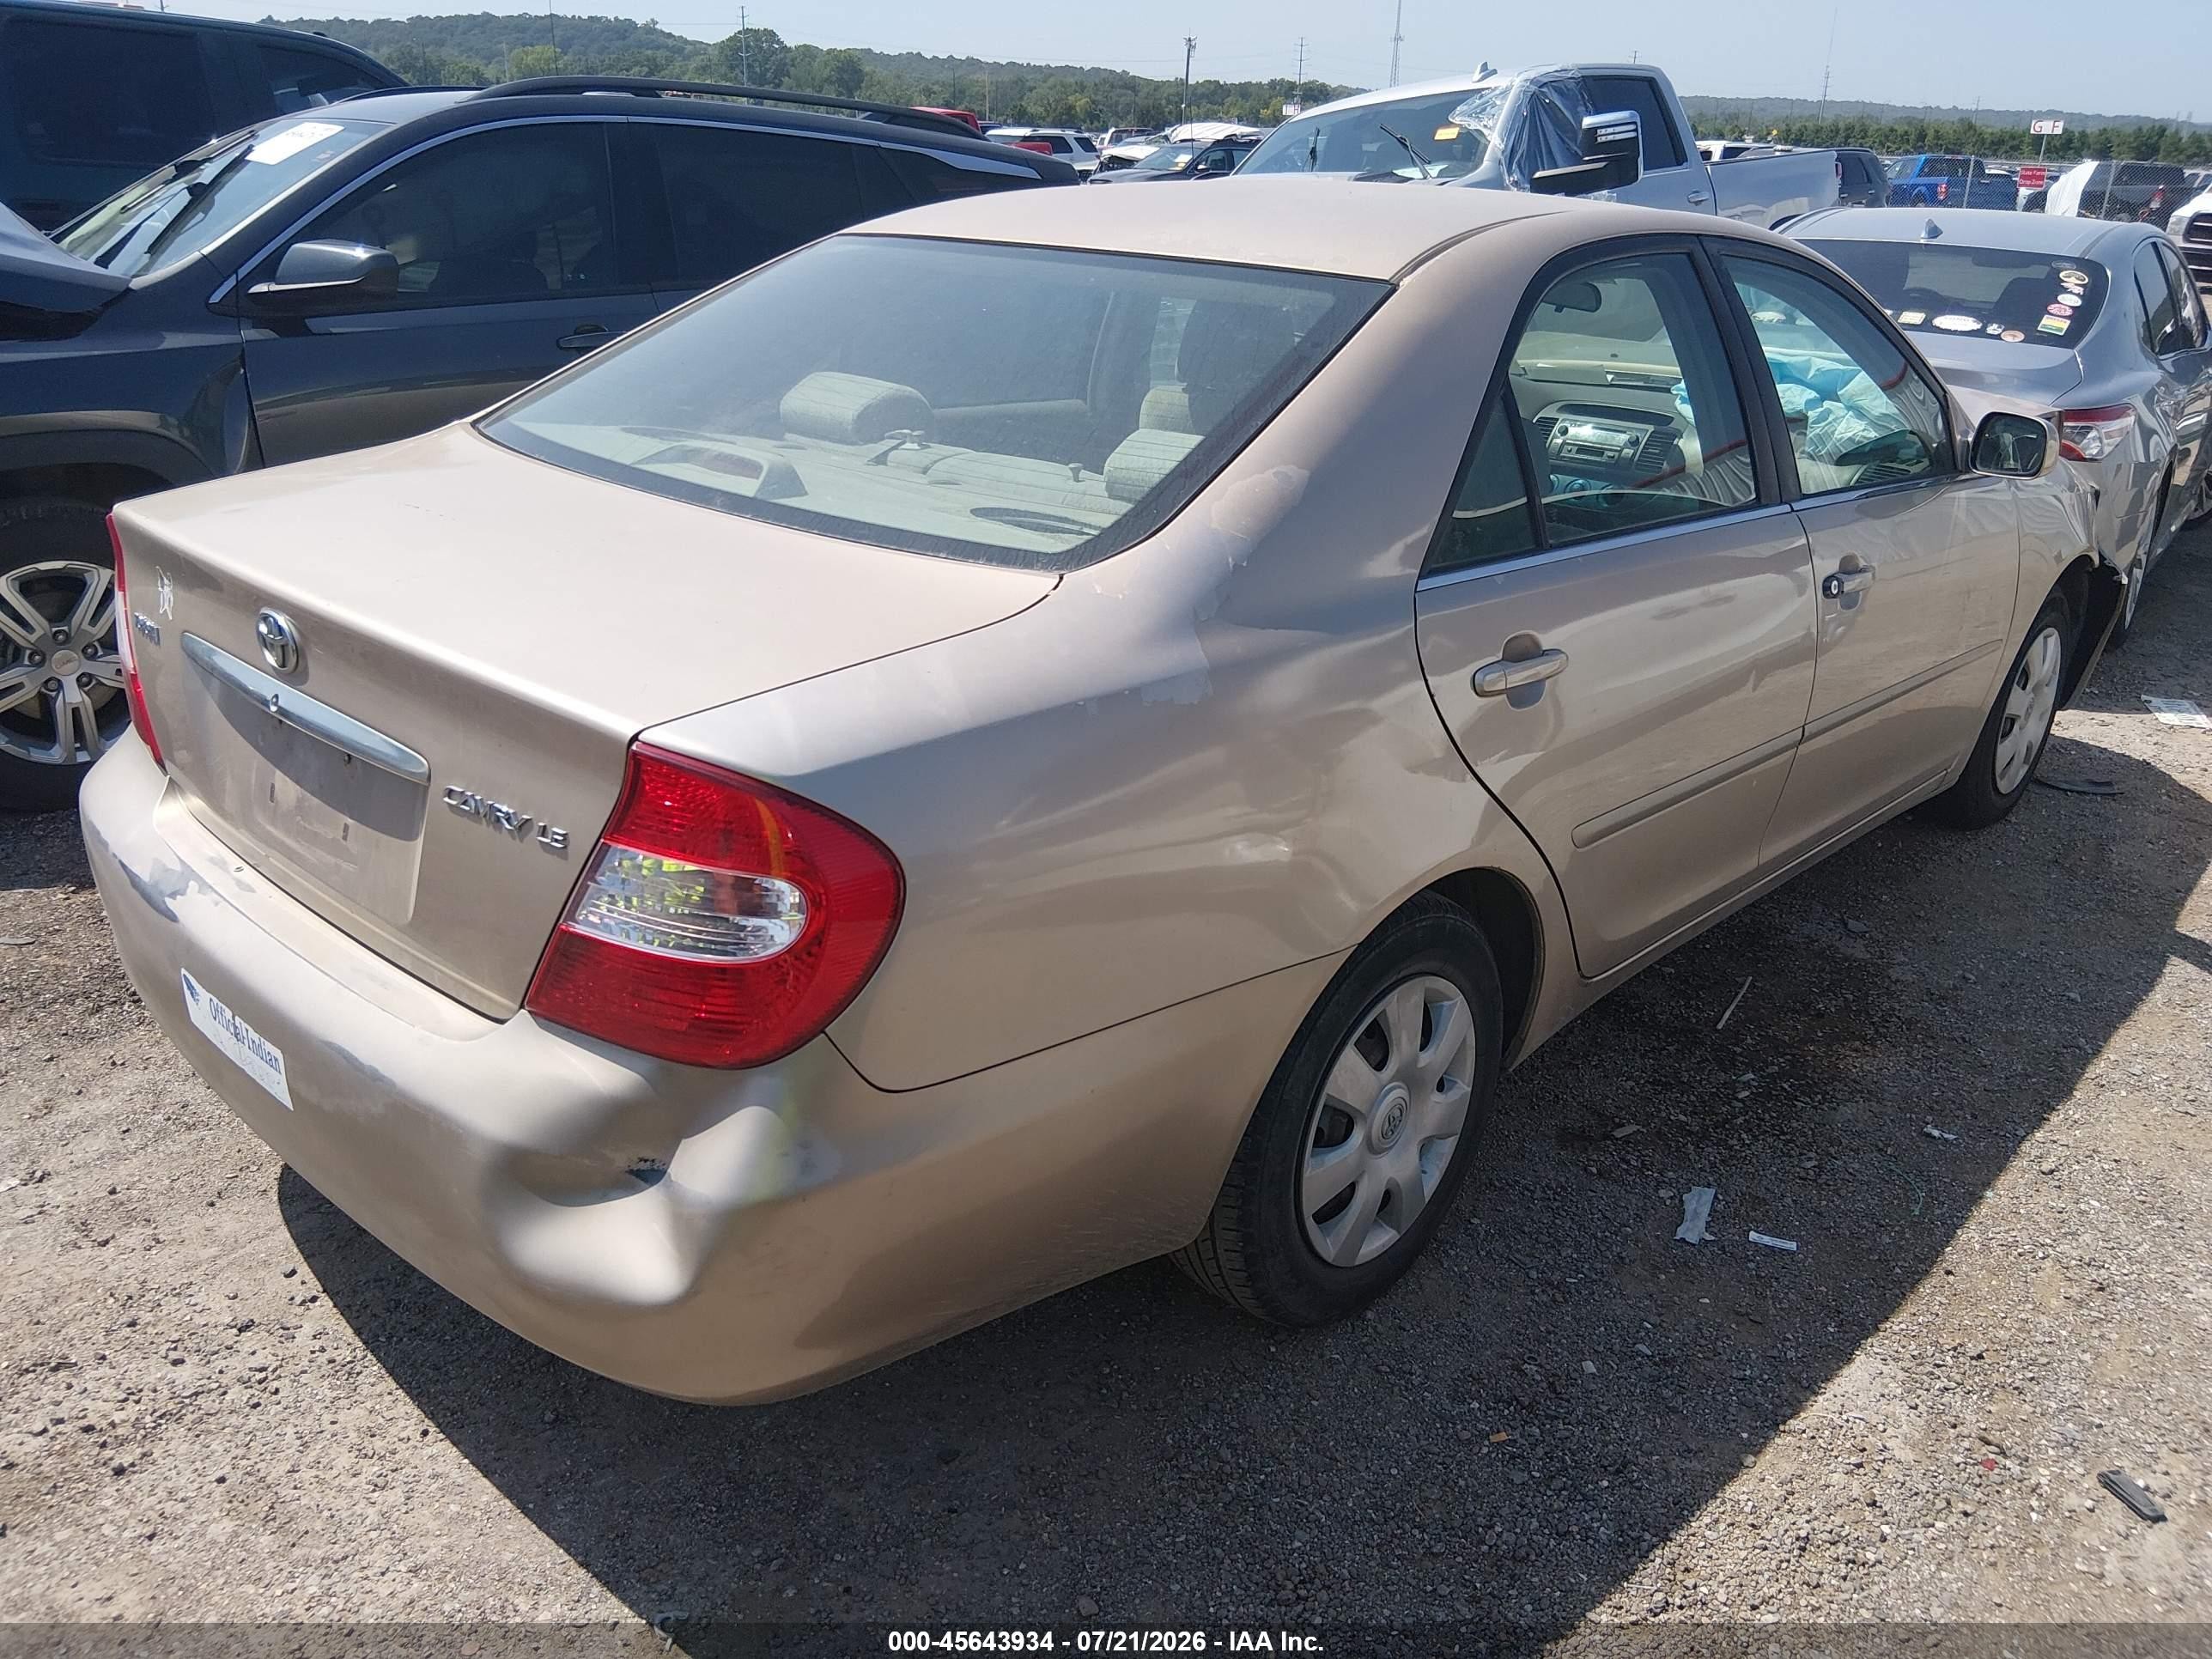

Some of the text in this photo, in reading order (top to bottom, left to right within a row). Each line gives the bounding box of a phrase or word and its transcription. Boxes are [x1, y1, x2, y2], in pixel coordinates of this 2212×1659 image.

[2033, 119, 2061, 133] G F
[442, 785, 569, 848] CAMRY LE
